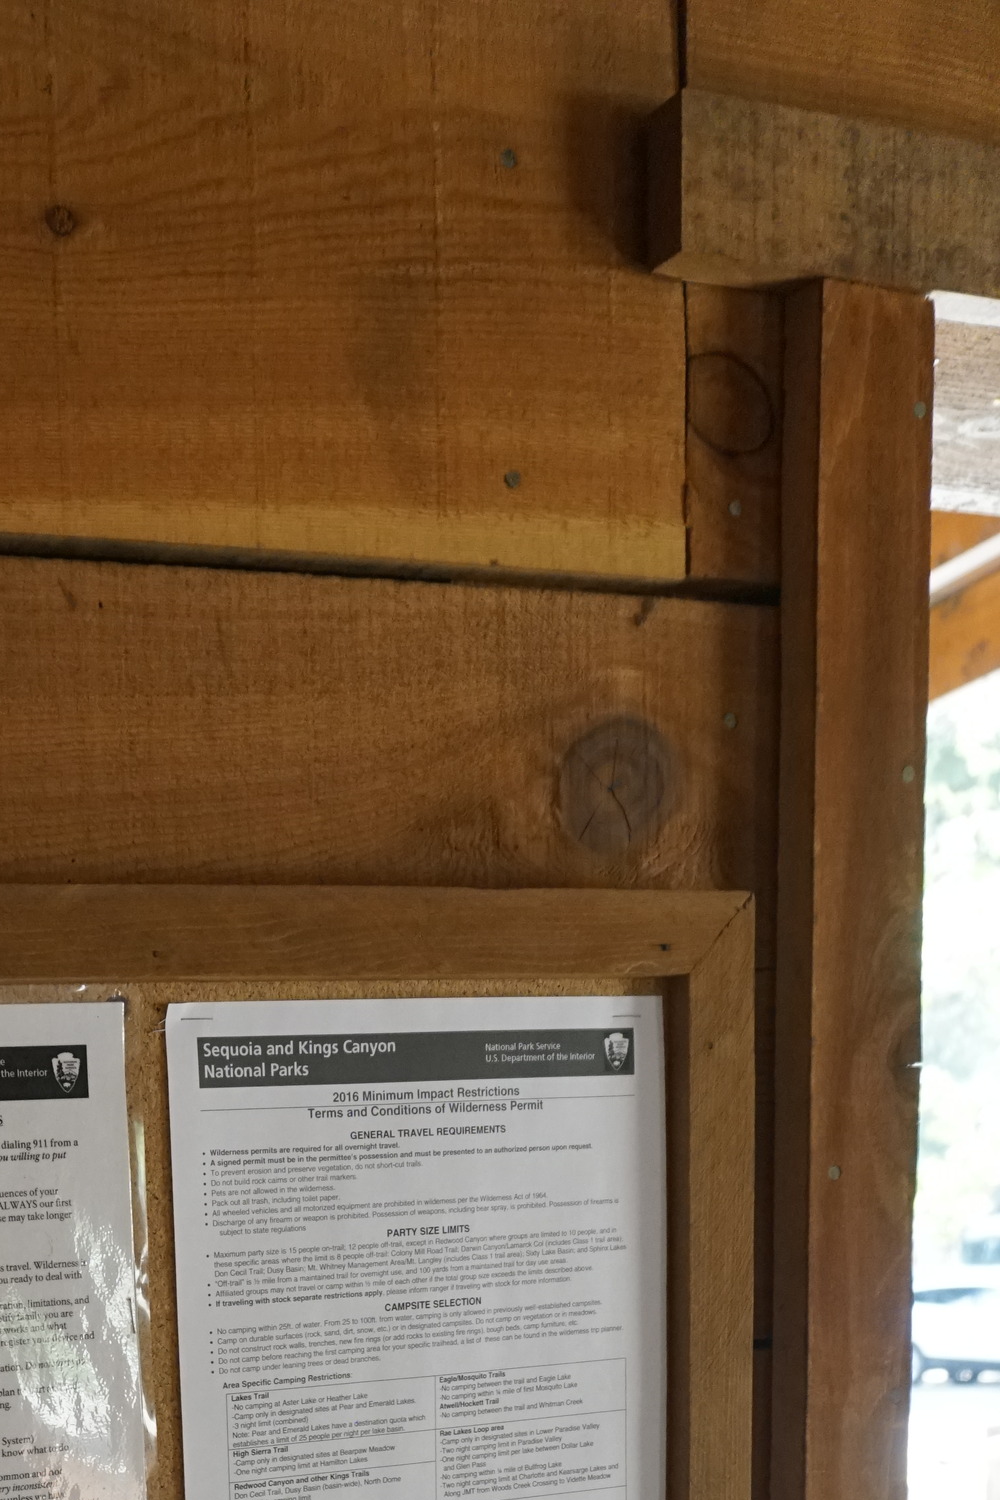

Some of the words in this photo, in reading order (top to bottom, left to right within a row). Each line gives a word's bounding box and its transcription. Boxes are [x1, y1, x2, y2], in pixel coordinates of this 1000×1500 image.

[203, 1042, 262, 1061] Sequoia
[266, 1040, 293, 1056] and
[298, 1039, 338, 1058] Kings
[342, 1038, 396, 1056] Canyon
[485, 1042, 516, 1051] National
[517, 1041, 534, 1051] Park
[535, 1041, 561, 1050] Service
[485, 1053, 497, 1063] U.S.
[500, 1053, 545, 1064] Department
[546, 1052, 554, 1061] of
[556, 1052, 568, 1061] the
[569, 1052, 596, 1061] Interior
[0, 1068, 15, 1078] the
[16, 1068, 48, 1078] Interior
[204, 1062, 265, 1078] National
[270, 1062, 309, 1077] Parks
[333, 1091, 358, 1103] 2016
[362, 1090, 413, 1102] Minimum
[416, 1088, 453, 1102] Impact
[456, 1086, 520, 1098] Restrictions
[307, 1107, 343, 1119] Terms
[346, 1106, 367, 1117] and
[370, 1104, 431, 1116] Conditions
[434, 1103, 445, 1114] of
[448, 1102, 506, 1114] Wilderness
[509, 1099, 544, 1111] Permit
[350, 1128, 394, 1140] GENERAL
[397, 1127, 433, 1138] TRAVEL
[436, 1124, 506, 1136] REQUIREMENTS
[210, 1148, 249, 1156] Wilderness
[250, 1146, 277, 1156] permits
[291, 1144, 321, 1154] required
[322, 1144, 332, 1152] for
[334, 1143, 343, 1151] all
[344, 1141, 377, 1152] overnight
[378, 1141, 400, 1149] travel.
[386, 1227, 417, 1238] PARTY
[419, 1225, 439, 1236] SIZE
[441, 1224, 470, 1234] LIMITS
[384, 1299, 430, 1312] CAMPSITE
[432, 1296, 482, 1308] SELECTION
[222, 1381, 240, 1390] Area
[241, 1378, 271, 1389] Specific
[272, 1376, 306, 1386] Camping
[307, 1372, 353, 1382] Restrictions:
